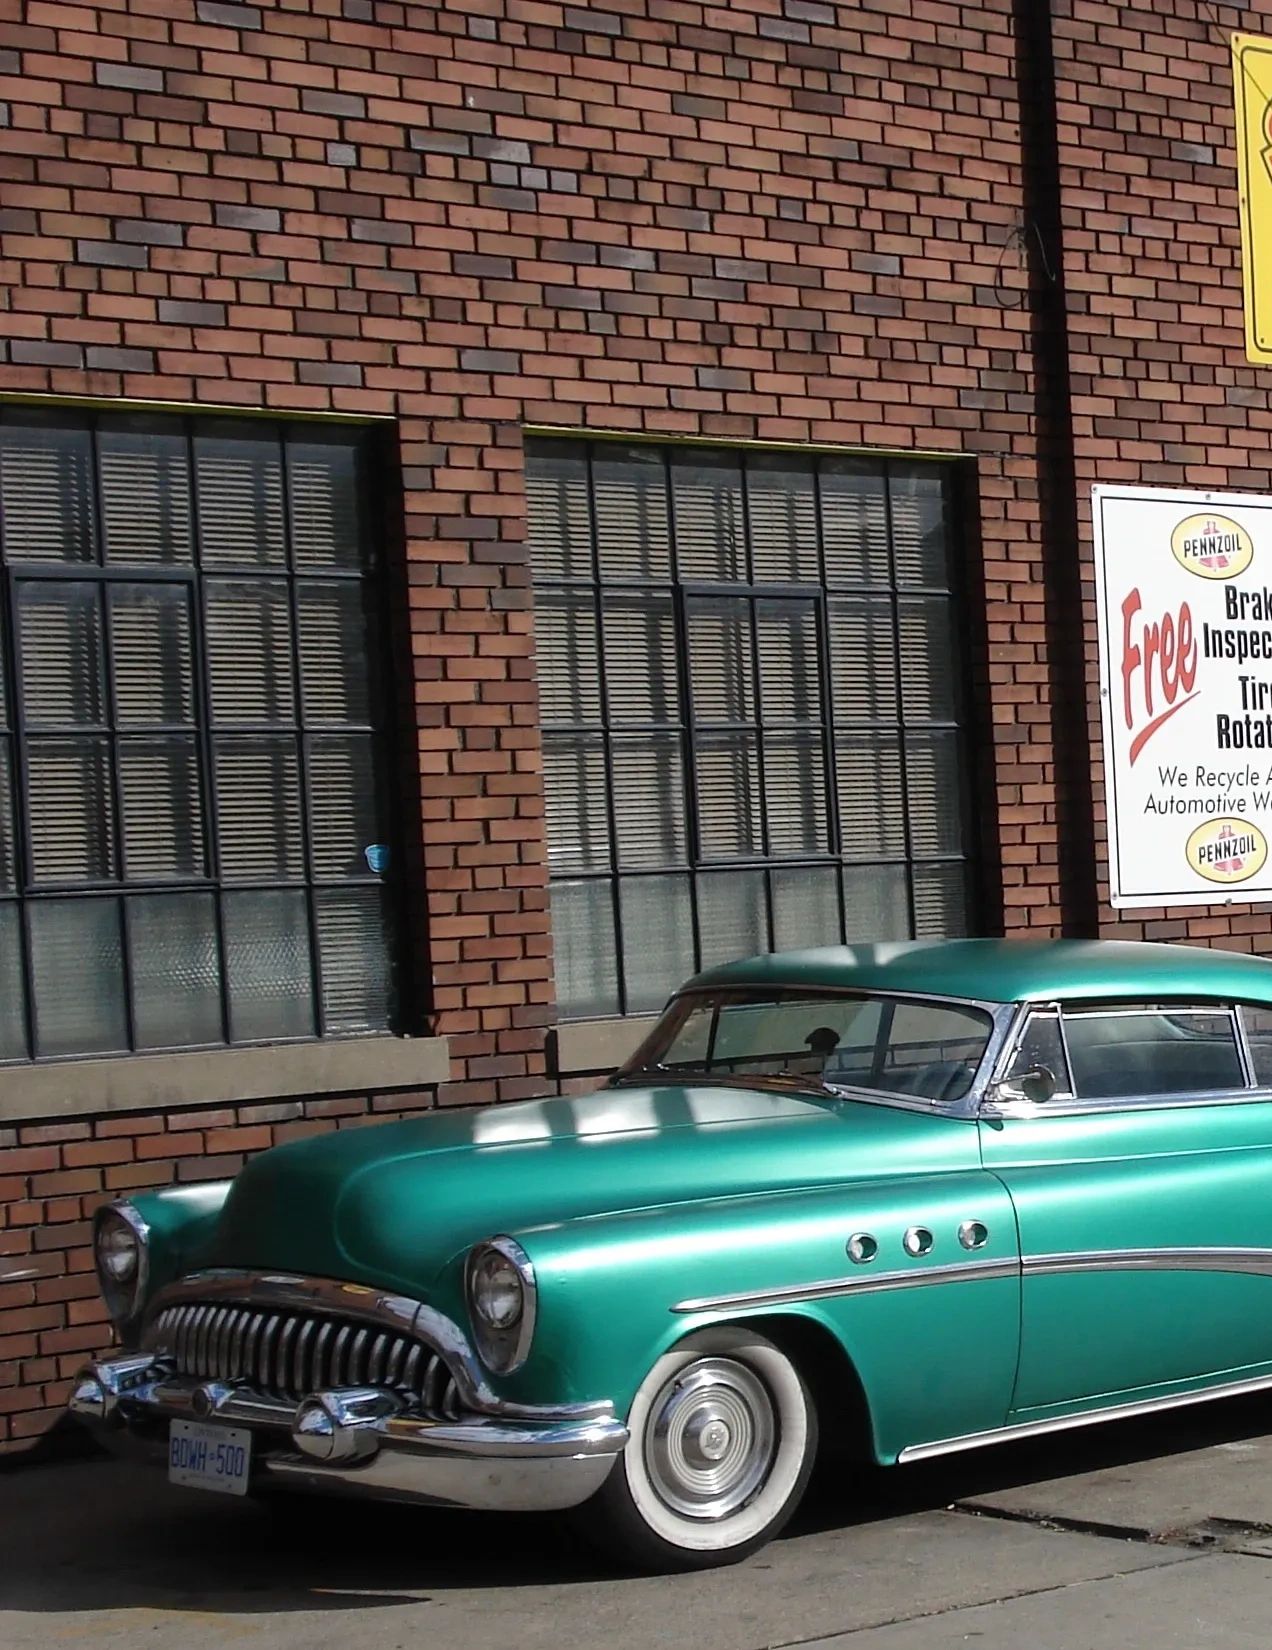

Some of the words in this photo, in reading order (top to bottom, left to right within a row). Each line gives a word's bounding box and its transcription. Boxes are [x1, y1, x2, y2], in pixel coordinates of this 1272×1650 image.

[1183, 532, 1242, 558] PENNZOIL
[1120, 587, 1200, 737] Free
[1157, 765, 1188, 788] We
[1195, 766, 1260, 794] Recycle
[1143, 793, 1247, 816] Automotive
[1198, 836, 1257, 863] PENNZOIL
